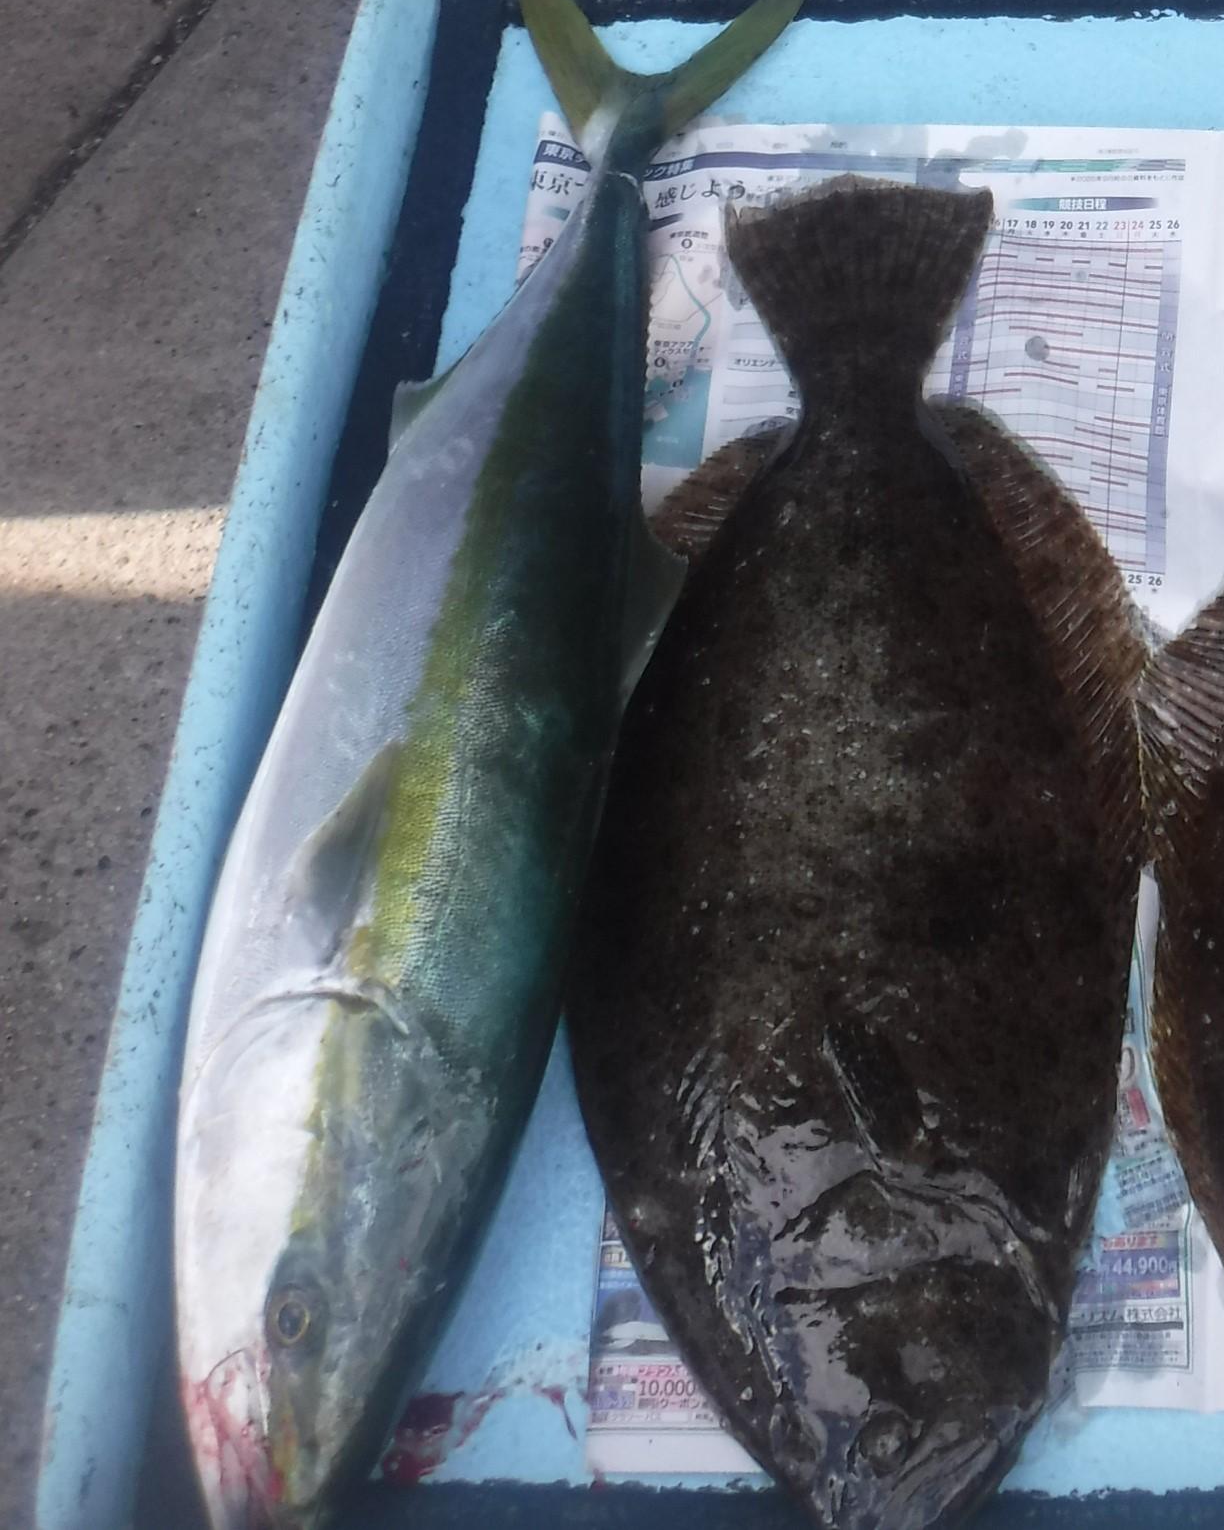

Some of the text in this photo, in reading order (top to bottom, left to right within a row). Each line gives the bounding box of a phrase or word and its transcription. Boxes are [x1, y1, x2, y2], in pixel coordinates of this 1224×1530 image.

[654, 178, 747, 209] 感じよう
[1006, 220, 1018, 228] 17
[1025, 220, 1037, 229] 18
[1043, 221, 1055, 229] 19
[1060, 221, 1073, 230] 20
[1077, 221, 1090, 230] 21
[1095, 221, 1109, 230] 22
[1113, 221, 1126, 230] 23
[1131, 221, 1144, 230] 24
[1149, 220, 1162, 230] 25
[1167, 220, 1180, 230] 26
[1127, 573, 1162, 586] 25 26
[638, 1379, 697, 1397] 10,000
